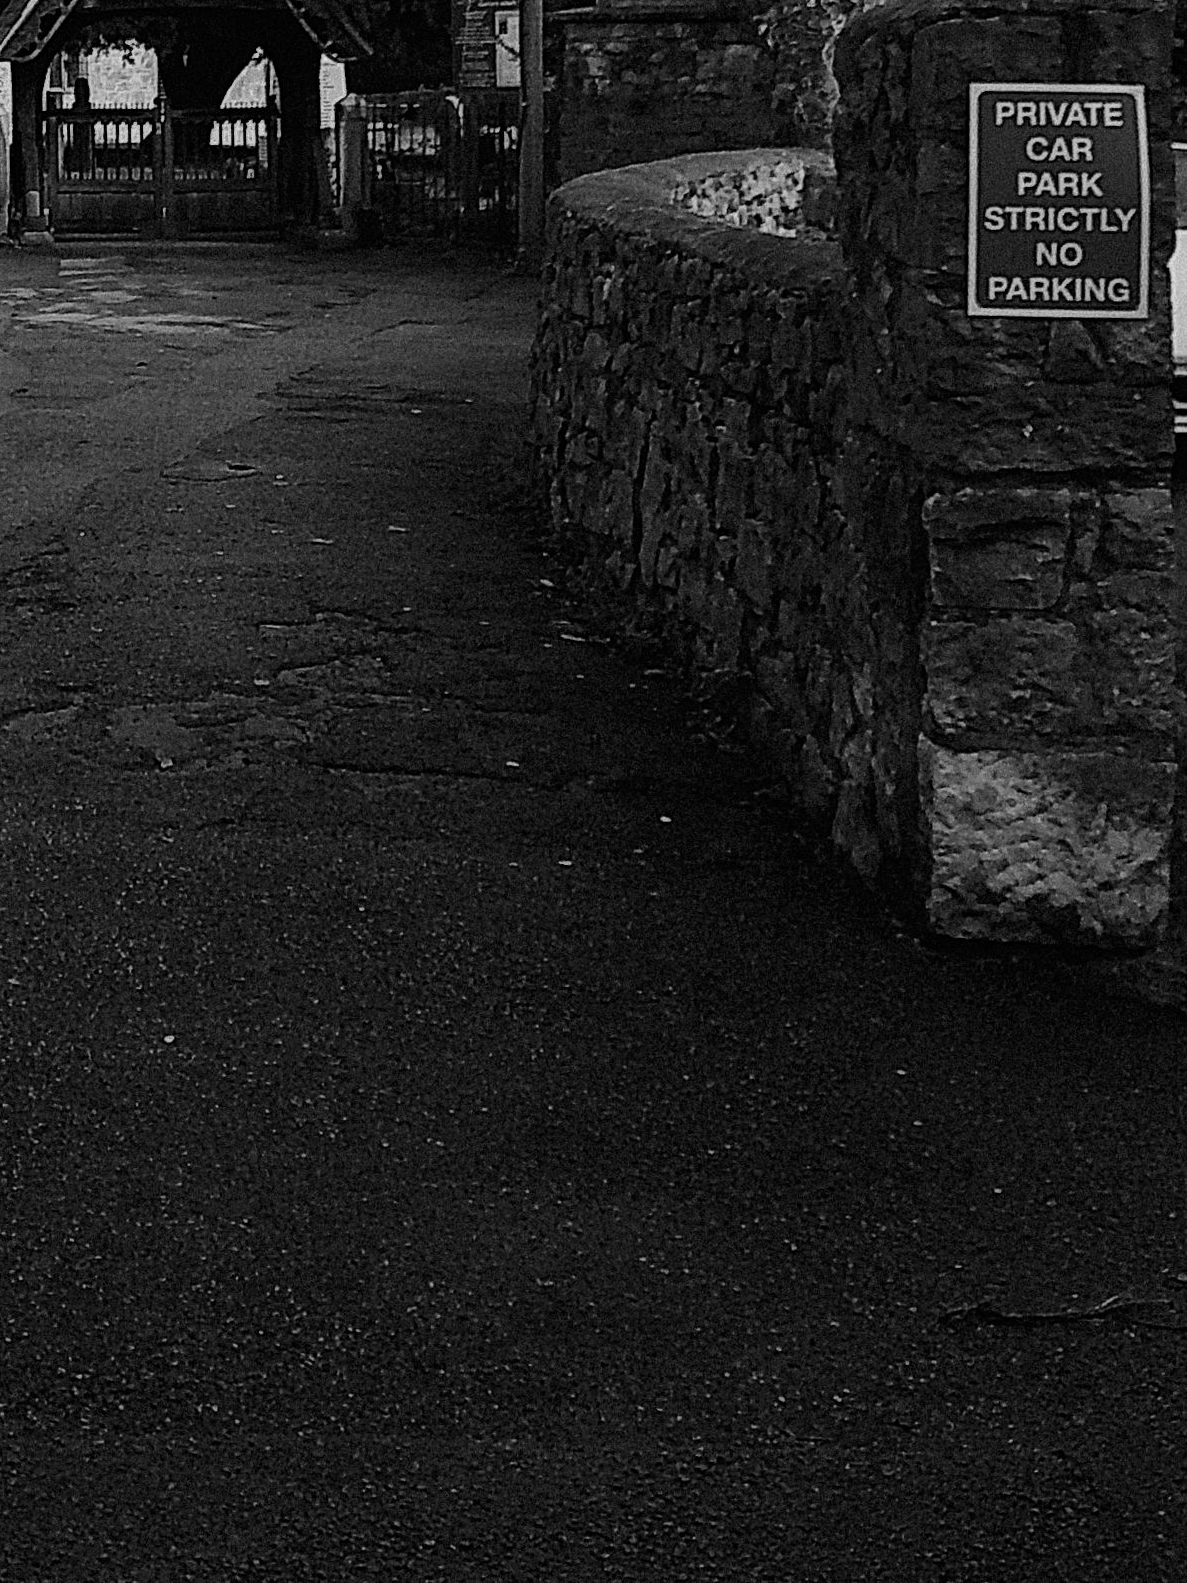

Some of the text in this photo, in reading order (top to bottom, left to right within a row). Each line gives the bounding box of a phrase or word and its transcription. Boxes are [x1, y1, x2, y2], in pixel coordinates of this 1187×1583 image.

[995, 101, 1124, 127] PRIVATE
[1025, 136, 1094, 162] CAR
[1017, 172, 1104, 197] PARK
[983, 206, 1137, 232] STRICTLY
[1036, 242, 1083, 267] NO
[988, 276, 1130, 303] PARKING
